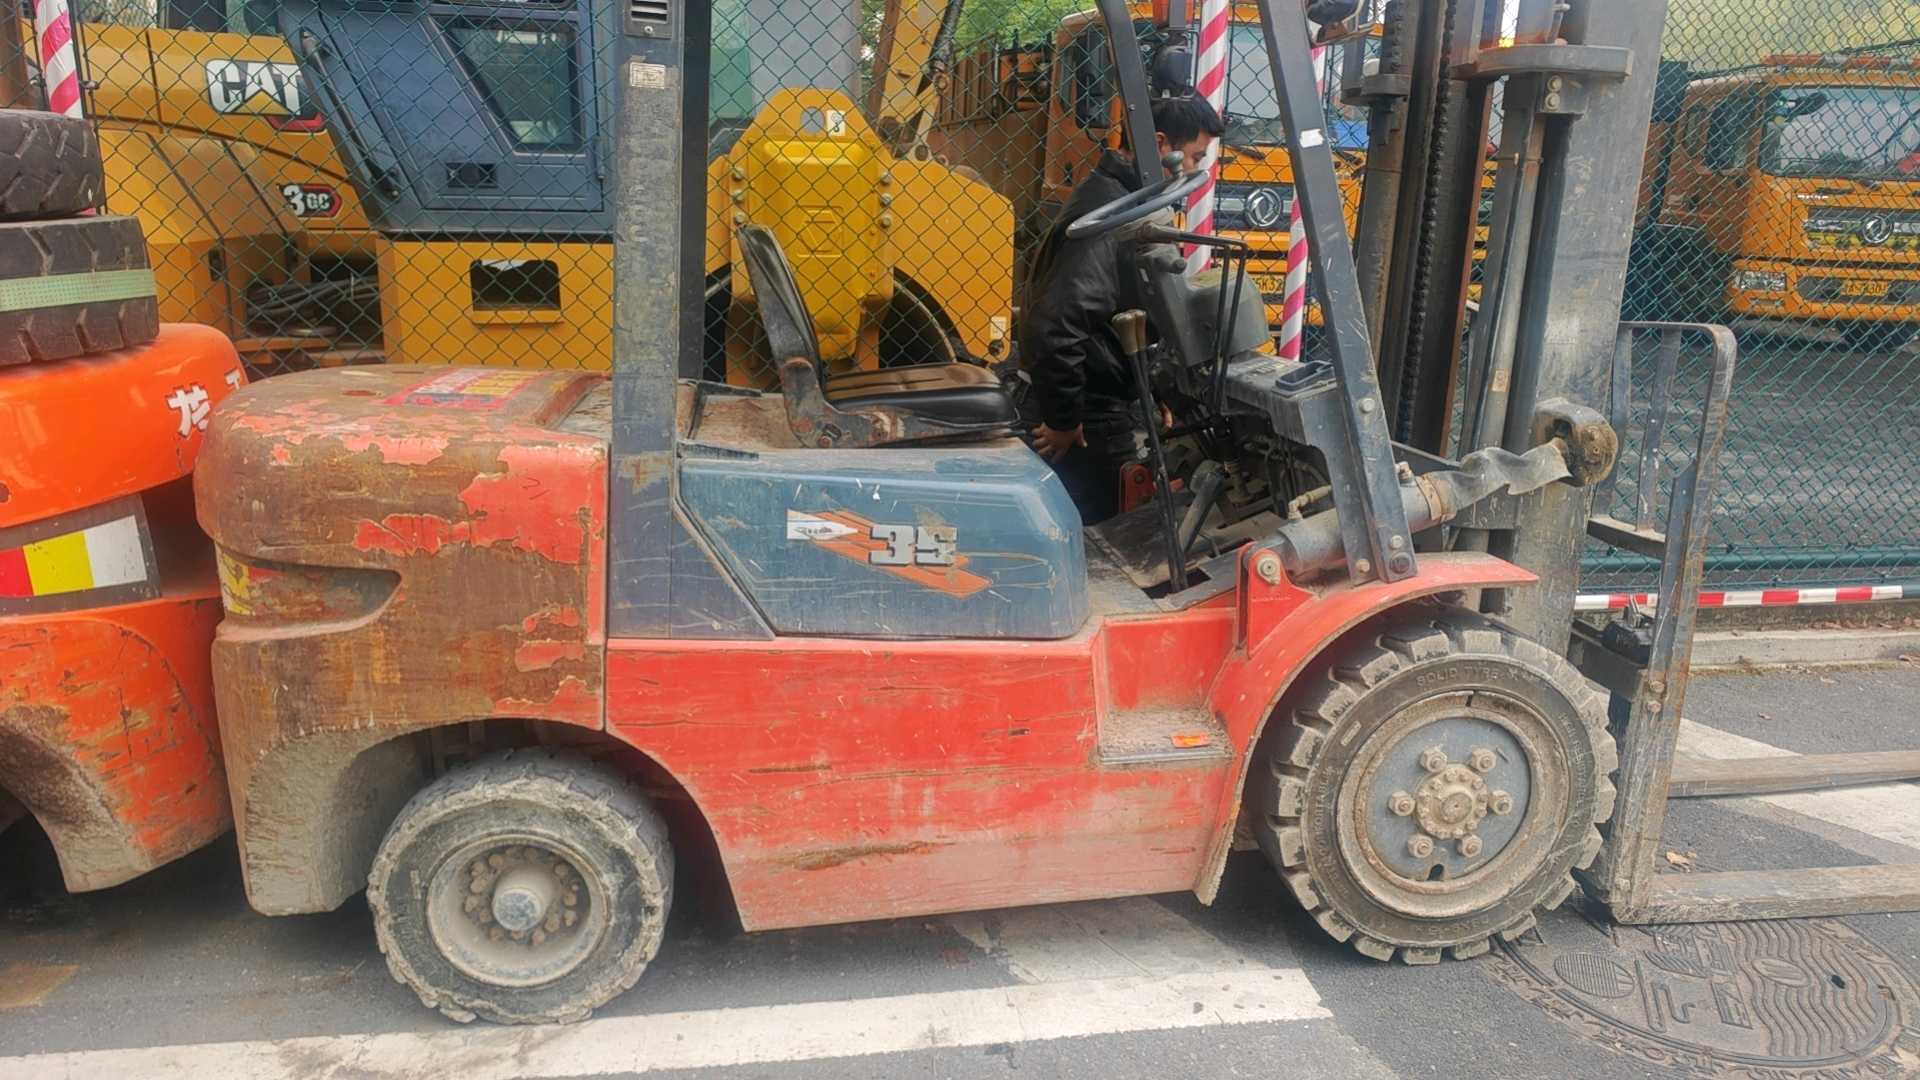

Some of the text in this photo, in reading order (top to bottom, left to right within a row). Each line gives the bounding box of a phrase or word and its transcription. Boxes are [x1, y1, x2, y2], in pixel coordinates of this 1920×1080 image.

[206, 60, 302, 115] CAT
[869, 525, 958, 566] 35
[1416, 667, 1459, 687] SOLID
